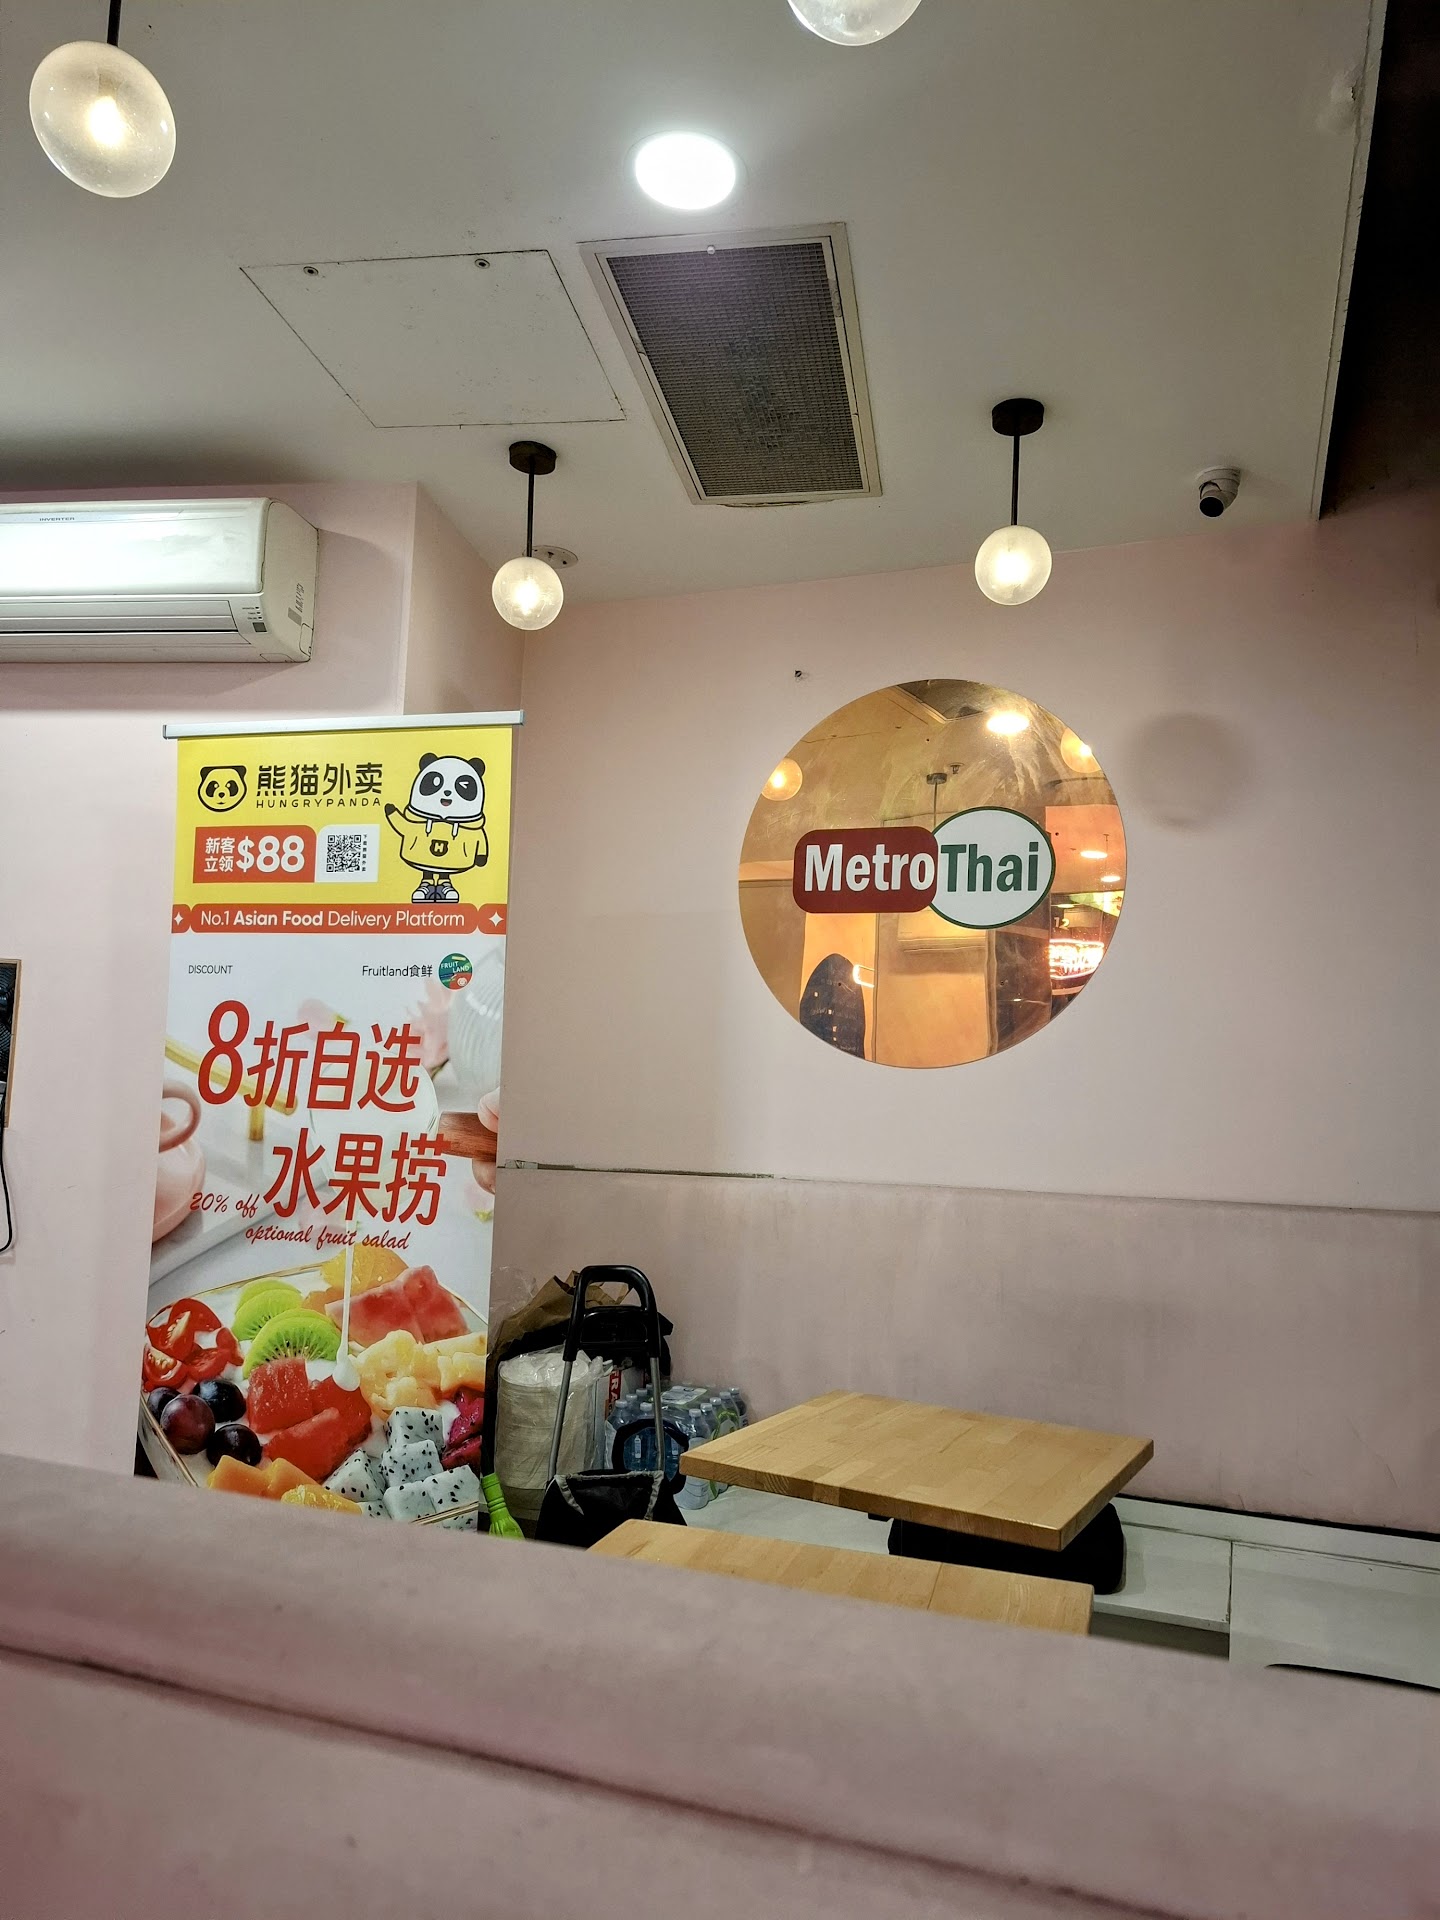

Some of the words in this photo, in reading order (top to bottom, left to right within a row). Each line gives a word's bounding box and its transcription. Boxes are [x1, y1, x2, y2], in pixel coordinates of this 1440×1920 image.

[256, 762, 383, 797] 熊猫外卖
[256, 797, 381, 809] HUNGRYPANDA
[205, 837, 236, 855] 新客
[236, 835, 305, 873] $88
[204, 855, 234, 873] 立领
[200, 910, 230, 926] No.1
[233, 910, 278, 926] Asian
[282, 911, 323, 926] Food
[328, 910, 391, 929] Delivery
[396, 910, 465, 927] Platform
[188, 965, 232, 975] DISCOUNT
[362, 964, 433, 978] Fruitland食鲜
[440, 961, 459, 970] FRUIT
[452, 965, 470, 974] LAND
[197, 1000, 422, 1113] 8折自选
[263, 1127, 452, 1226] 水果捞
[190, 1192, 228, 1213] 20%
[235, 1194, 260, 1217] off
[245, 1225, 312, 1244] optional
[316, 1231, 356, 1251] fruit
[361, 1233, 411, 1250] salad
